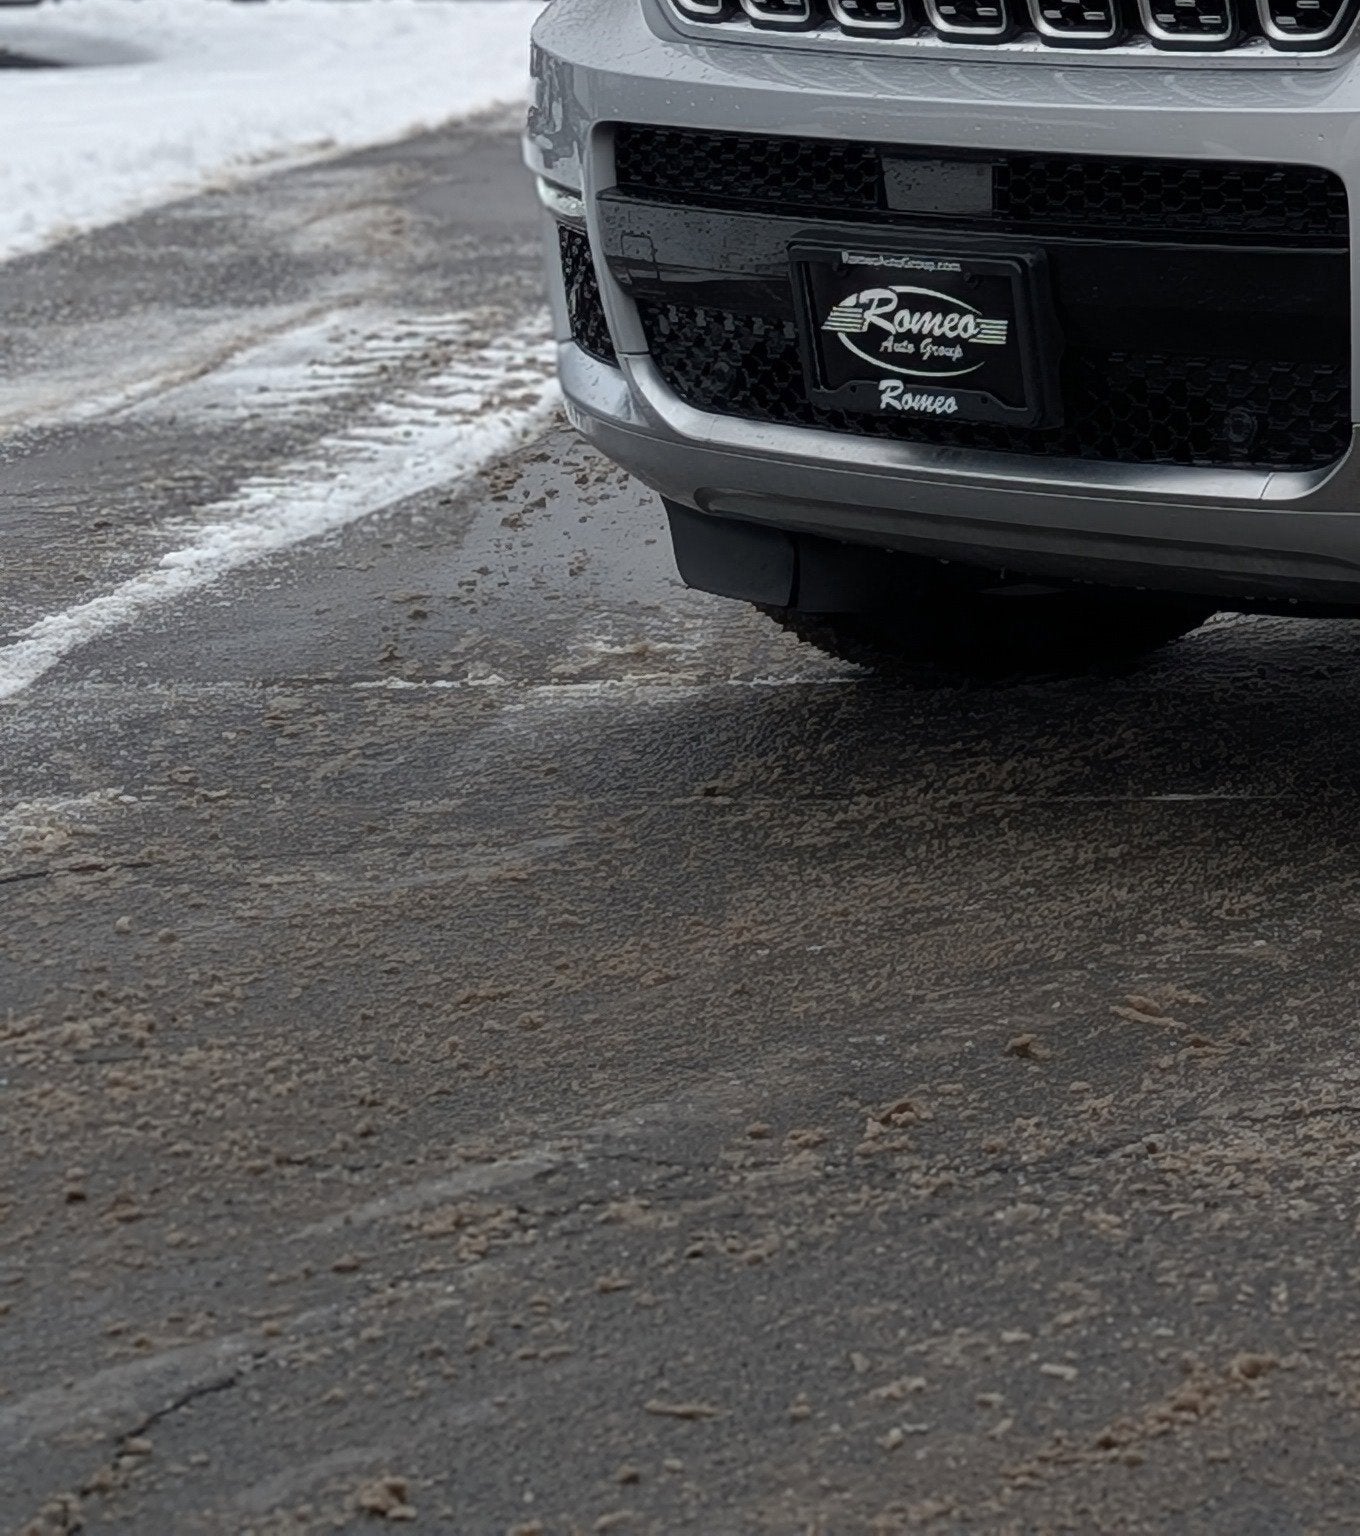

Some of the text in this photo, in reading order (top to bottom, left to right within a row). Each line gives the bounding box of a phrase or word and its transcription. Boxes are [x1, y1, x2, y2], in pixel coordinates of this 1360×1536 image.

[858, 287, 978, 337] Romeo
[879, 335, 964, 361] Auto Group
[878, 378, 958, 414] Romeo
